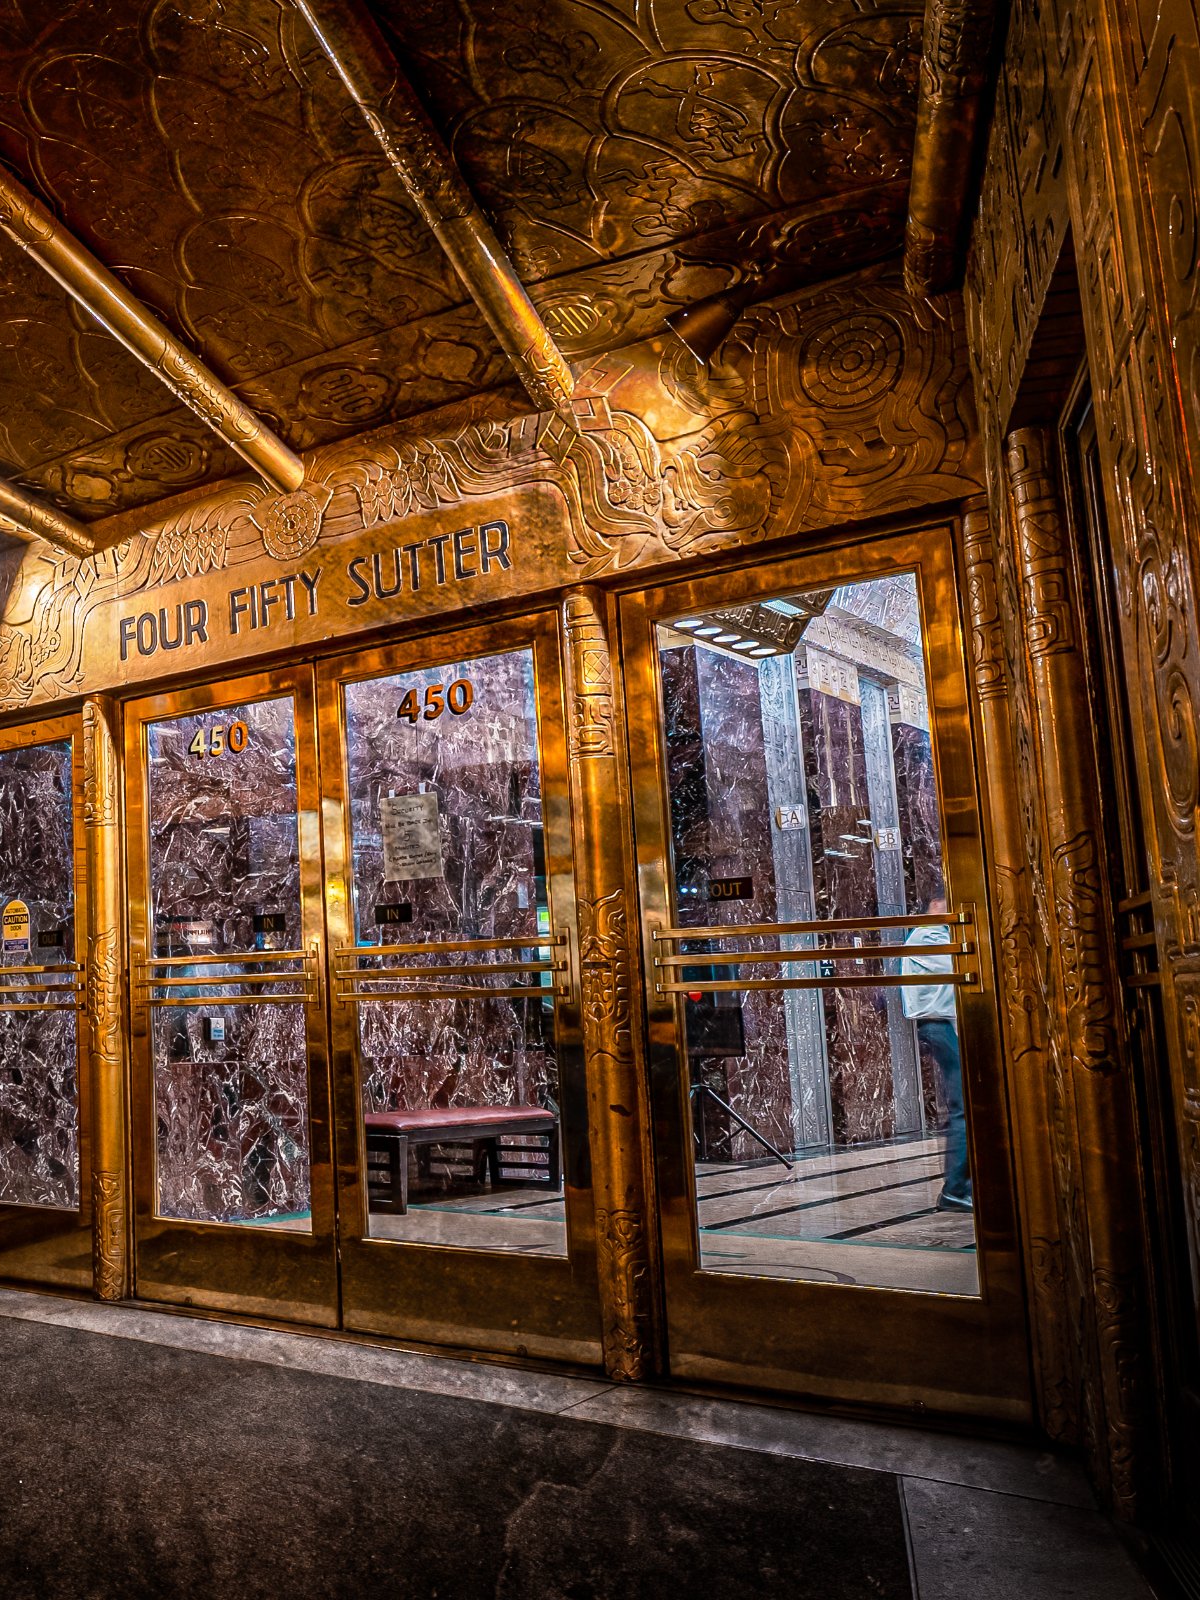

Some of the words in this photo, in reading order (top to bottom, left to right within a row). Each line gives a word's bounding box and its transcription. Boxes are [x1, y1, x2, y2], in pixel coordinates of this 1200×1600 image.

[119, 599, 209, 661] FOUR
[229, 566, 324, 636] FIFTY
[345, 518, 512, 607] SUTTER
[396, 678, 474, 724] 450
[188, 720, 249, 760] 450
[790, 810, 800, 824] A
[886, 832, 896, 845] B
[711, 882, 743, 897] OUT
[4, 915, 28, 924] CAUTION
[386, 909, 399, 920] IN
[263, 917, 275, 929] IN
[42, 933, 58, 945] OUT
